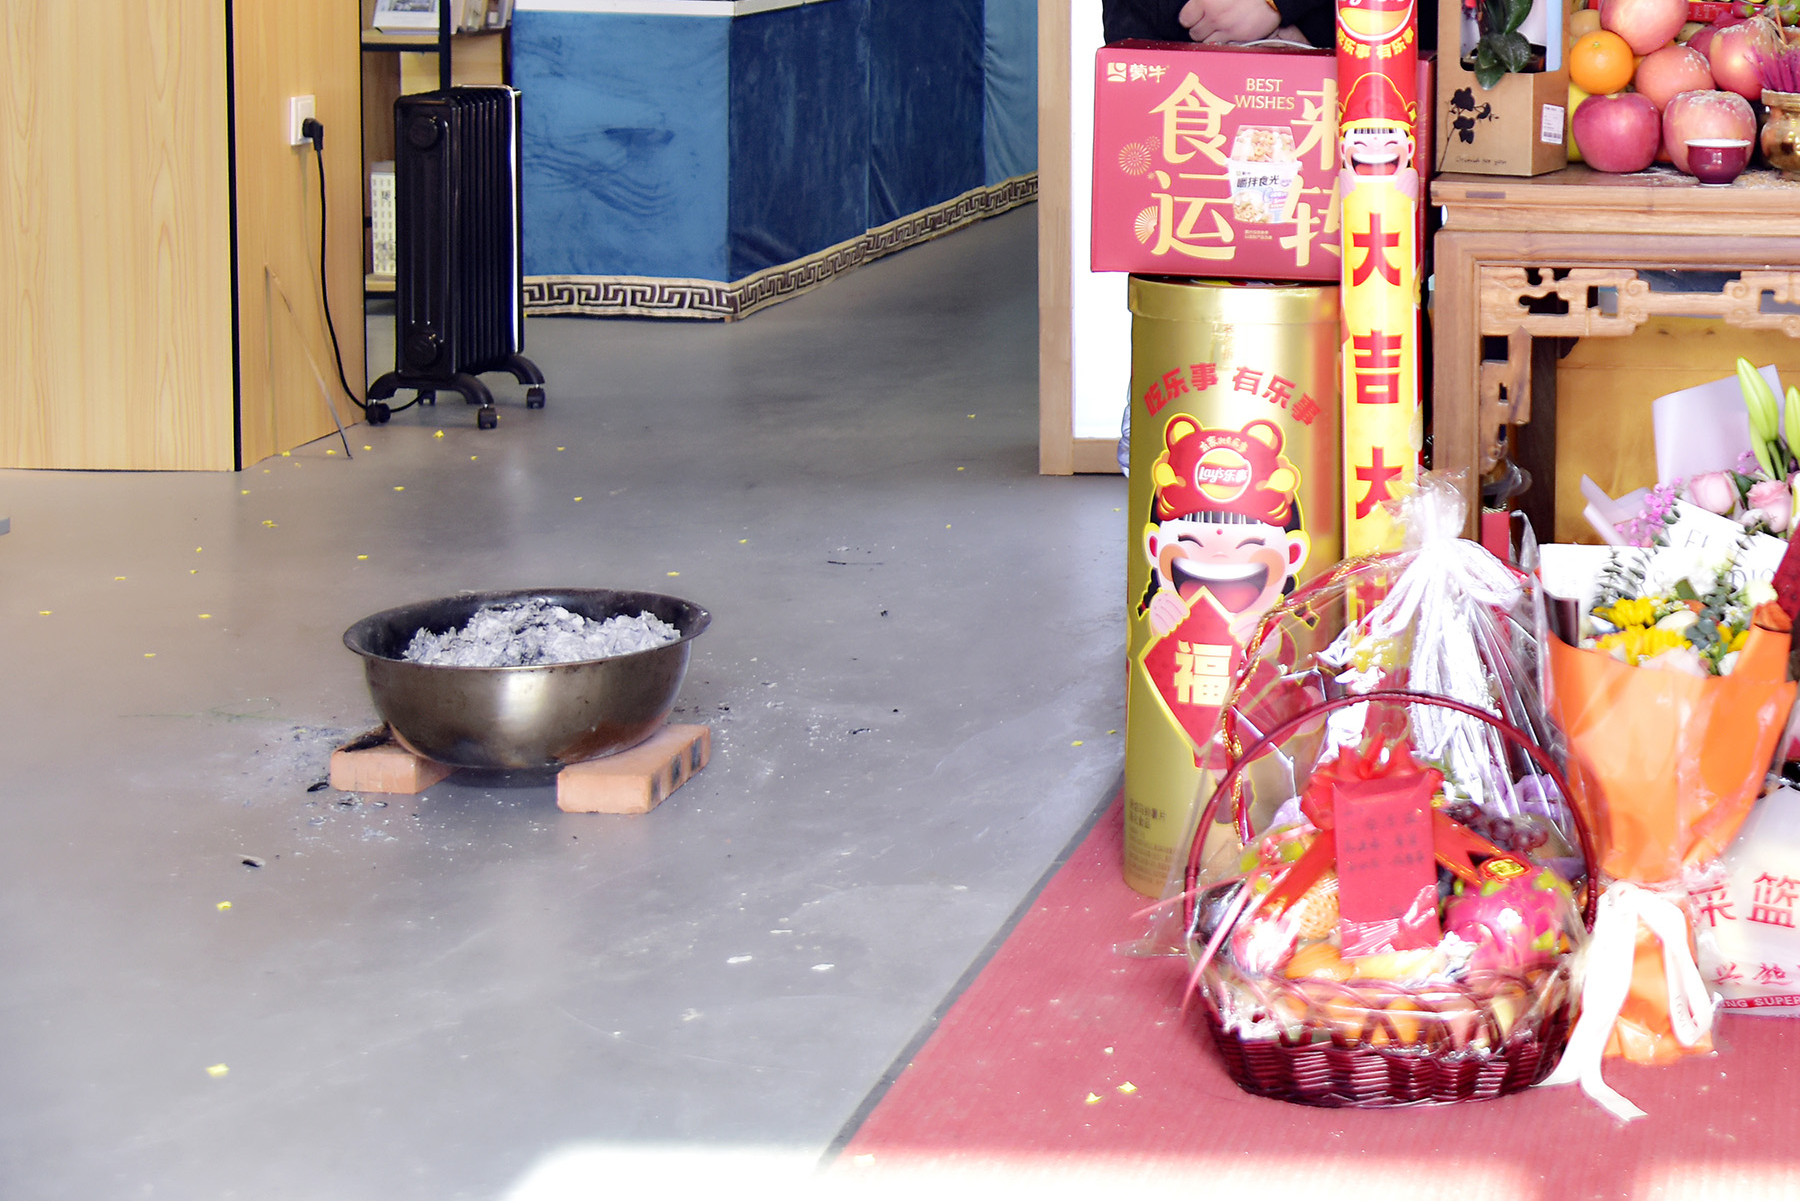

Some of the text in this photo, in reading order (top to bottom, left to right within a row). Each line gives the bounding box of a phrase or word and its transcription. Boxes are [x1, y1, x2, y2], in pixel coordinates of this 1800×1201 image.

[1130, 63, 1166, 83] 蒙牛
[1246, 77, 1283, 93] BEST
[1234, 94, 1296, 111] WISHES
[1143, 362, 1322, 426] 吃乐事 有乐事
[1174, 641, 1233, 704] 福
